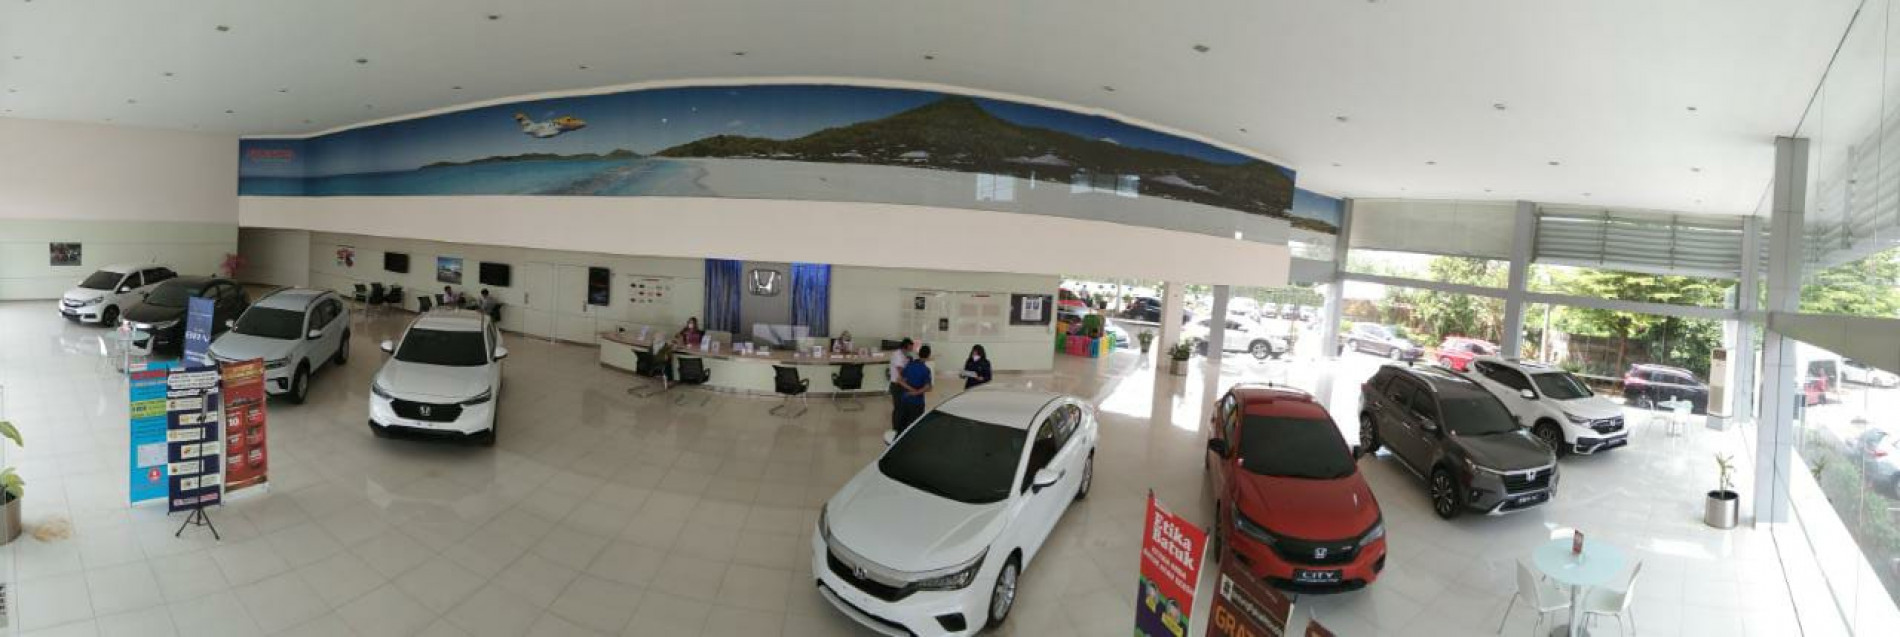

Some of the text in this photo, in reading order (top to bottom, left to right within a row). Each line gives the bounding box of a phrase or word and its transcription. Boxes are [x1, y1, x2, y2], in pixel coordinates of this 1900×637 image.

[1152, 526, 1195, 571] Batuk
[1153, 510, 1192, 552] Etika
[1302, 570, 1334, 579] CITY
[1215, 605, 1256, 637] GRA
